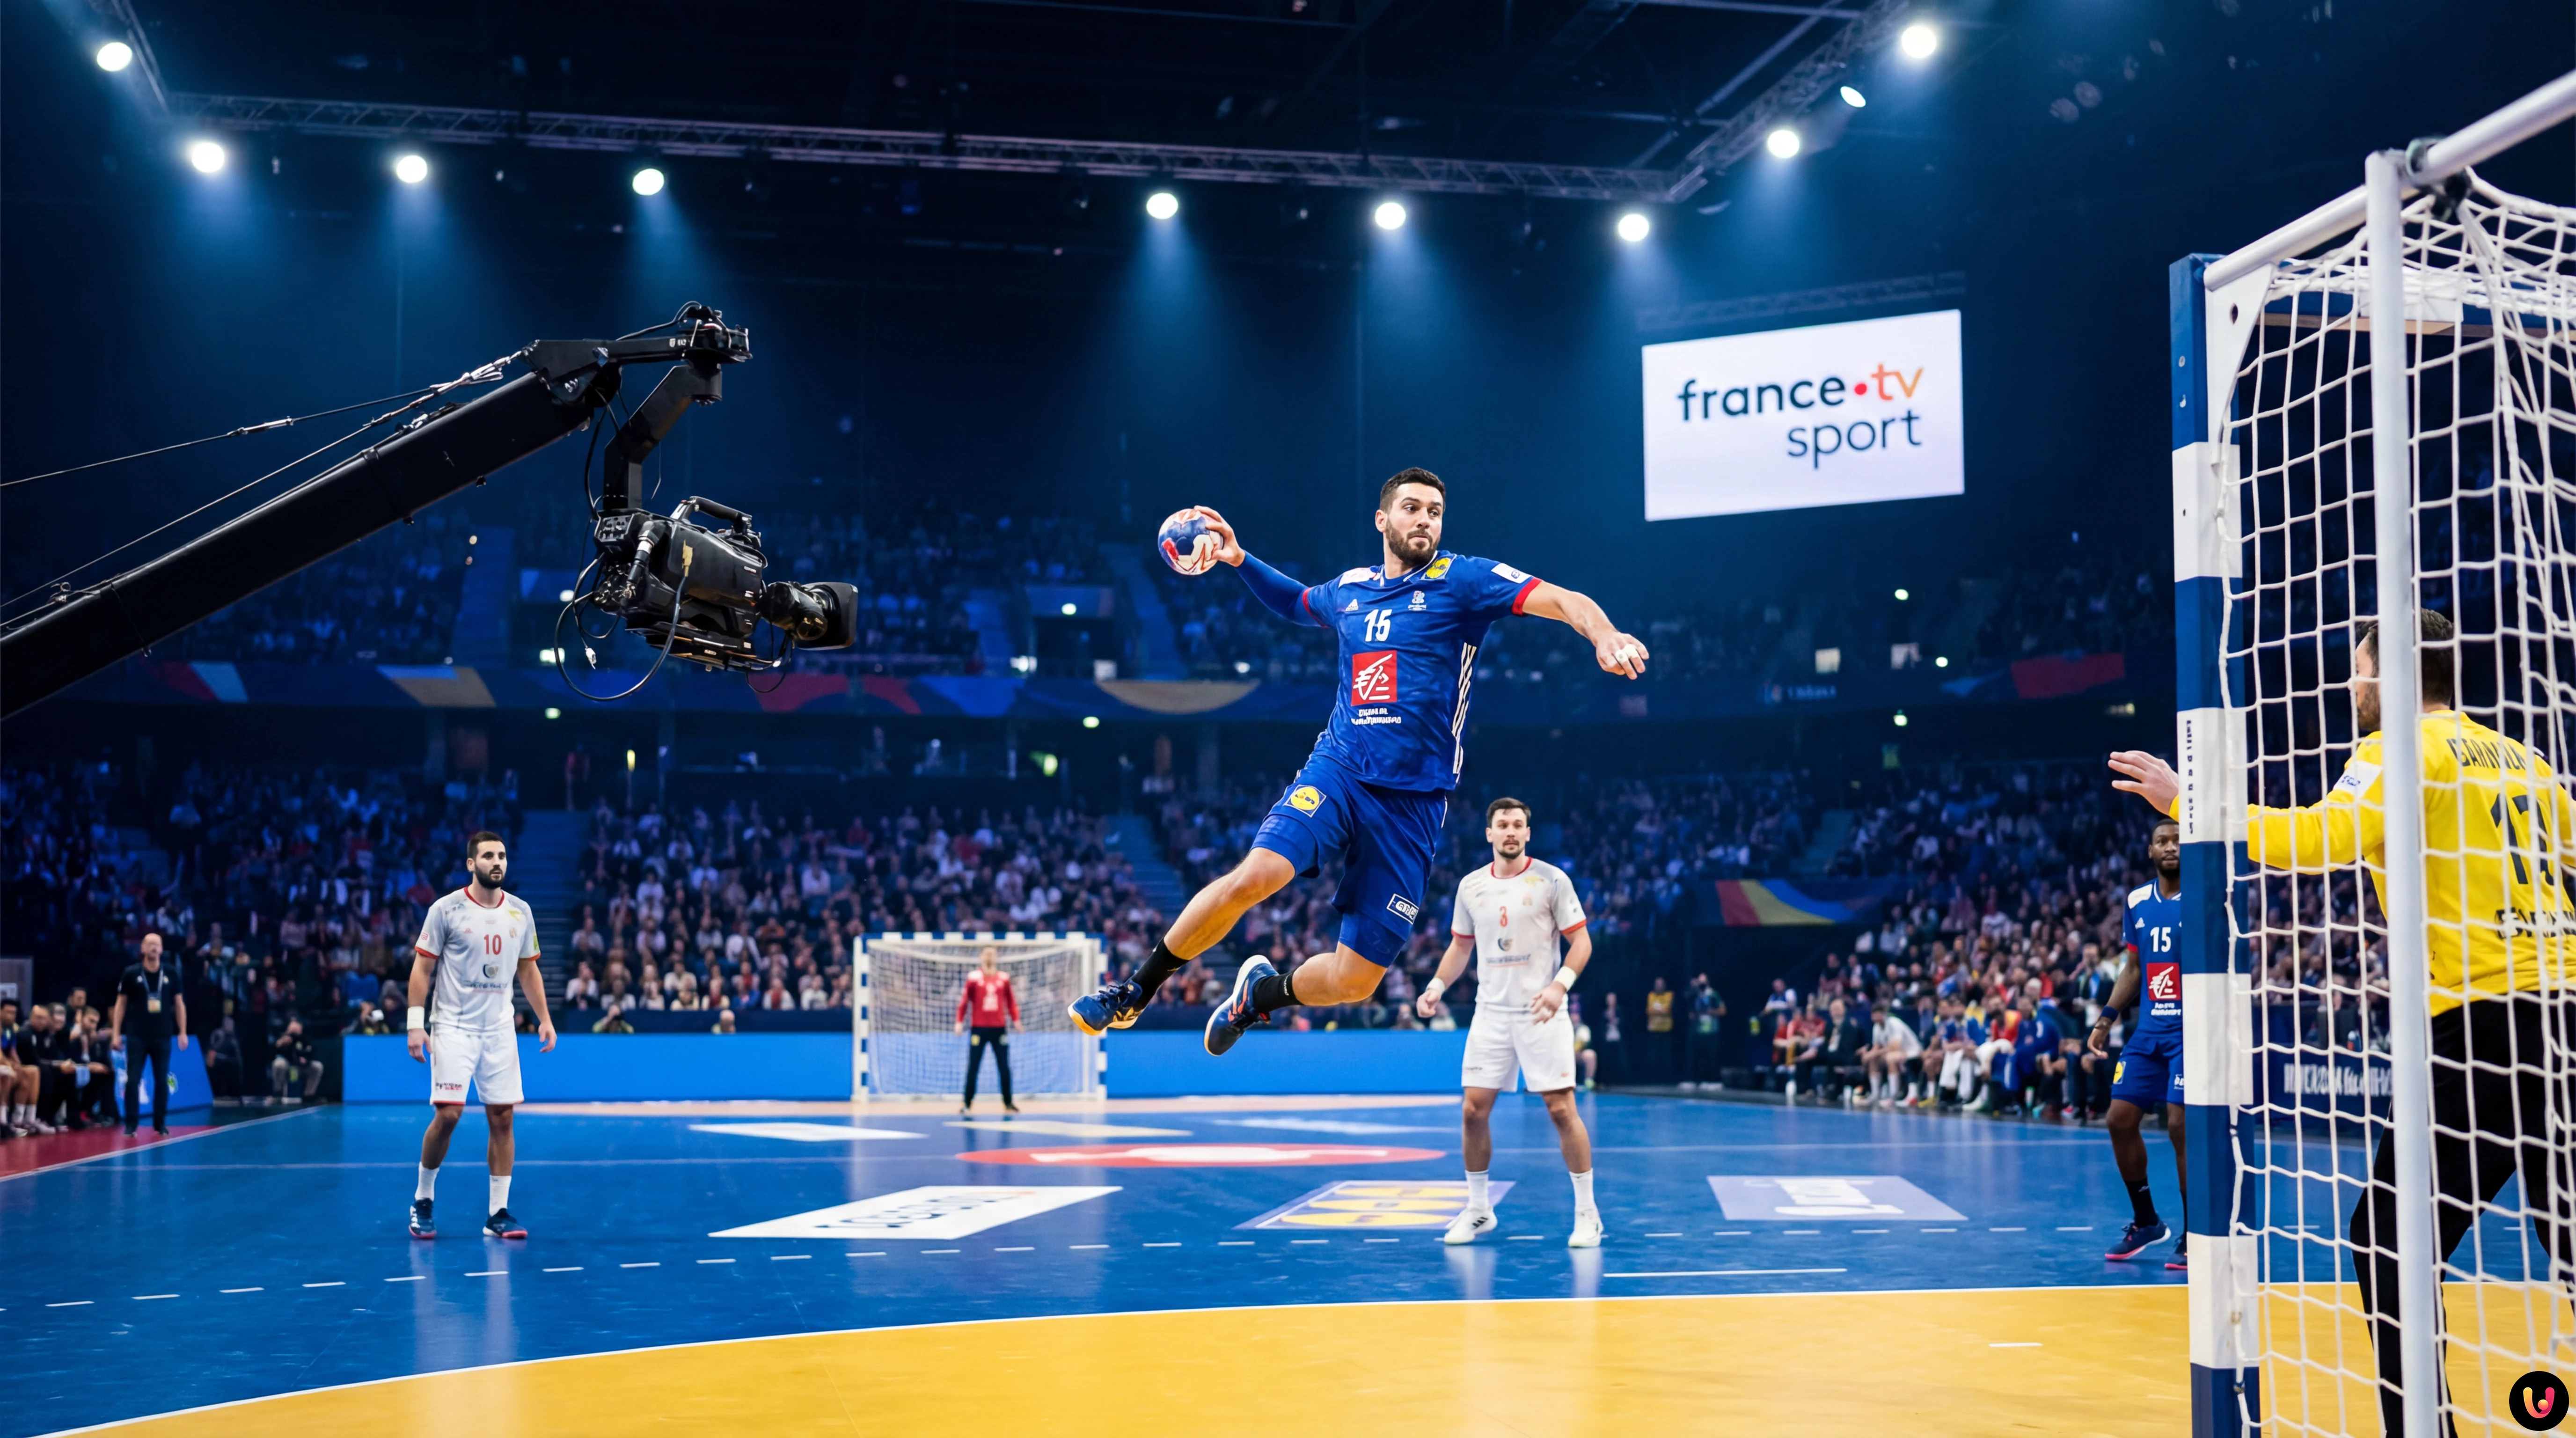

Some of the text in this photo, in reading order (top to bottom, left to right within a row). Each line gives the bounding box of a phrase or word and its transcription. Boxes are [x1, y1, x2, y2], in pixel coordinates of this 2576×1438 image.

[1787, 410, 1922, 470] sport
[483, 934, 502, 955] 10
[2150, 926, 2171, 952] 15
